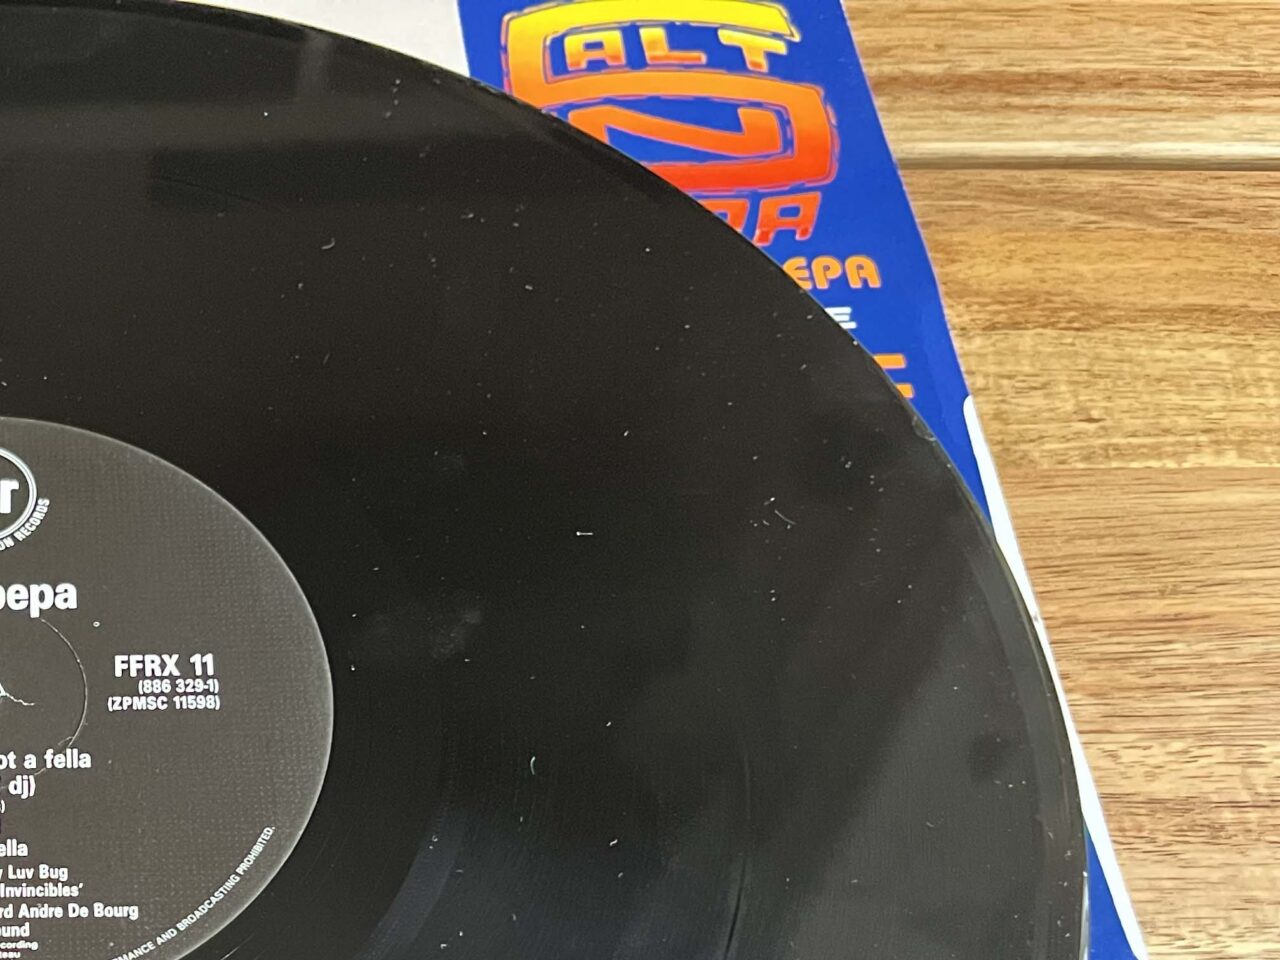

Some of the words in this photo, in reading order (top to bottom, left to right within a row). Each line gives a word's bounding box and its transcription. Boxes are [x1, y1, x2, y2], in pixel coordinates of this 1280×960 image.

[783, 256, 881, 289] EPA
[14, 497, 50, 541] RECORDS
[114, 654, 181, 677] FFRX
[189, 653, 215, 676] 11
[138, 679, 172, 694] (886
[175, 679, 220, 693] 329-1)
[107, 696, 168, 712] (ZPMSC
[172, 694, 221, 710] 11598)
[23, 753, 37, 769] a
[44, 748, 92, 769] fella
[8, 775, 36, 798] dj)
[8, 865, 35, 880] Luv
[38, 864, 69, 882] Bug
[155, 928, 178, 946] AND
[176, 874, 240, 931] BROADCASTING
[236, 826, 276, 876] PROHIBITED.
[18, 902, 64, 919] Andre
[68, 902, 89, 918] De
[93, 902, 139, 920] Bourg
